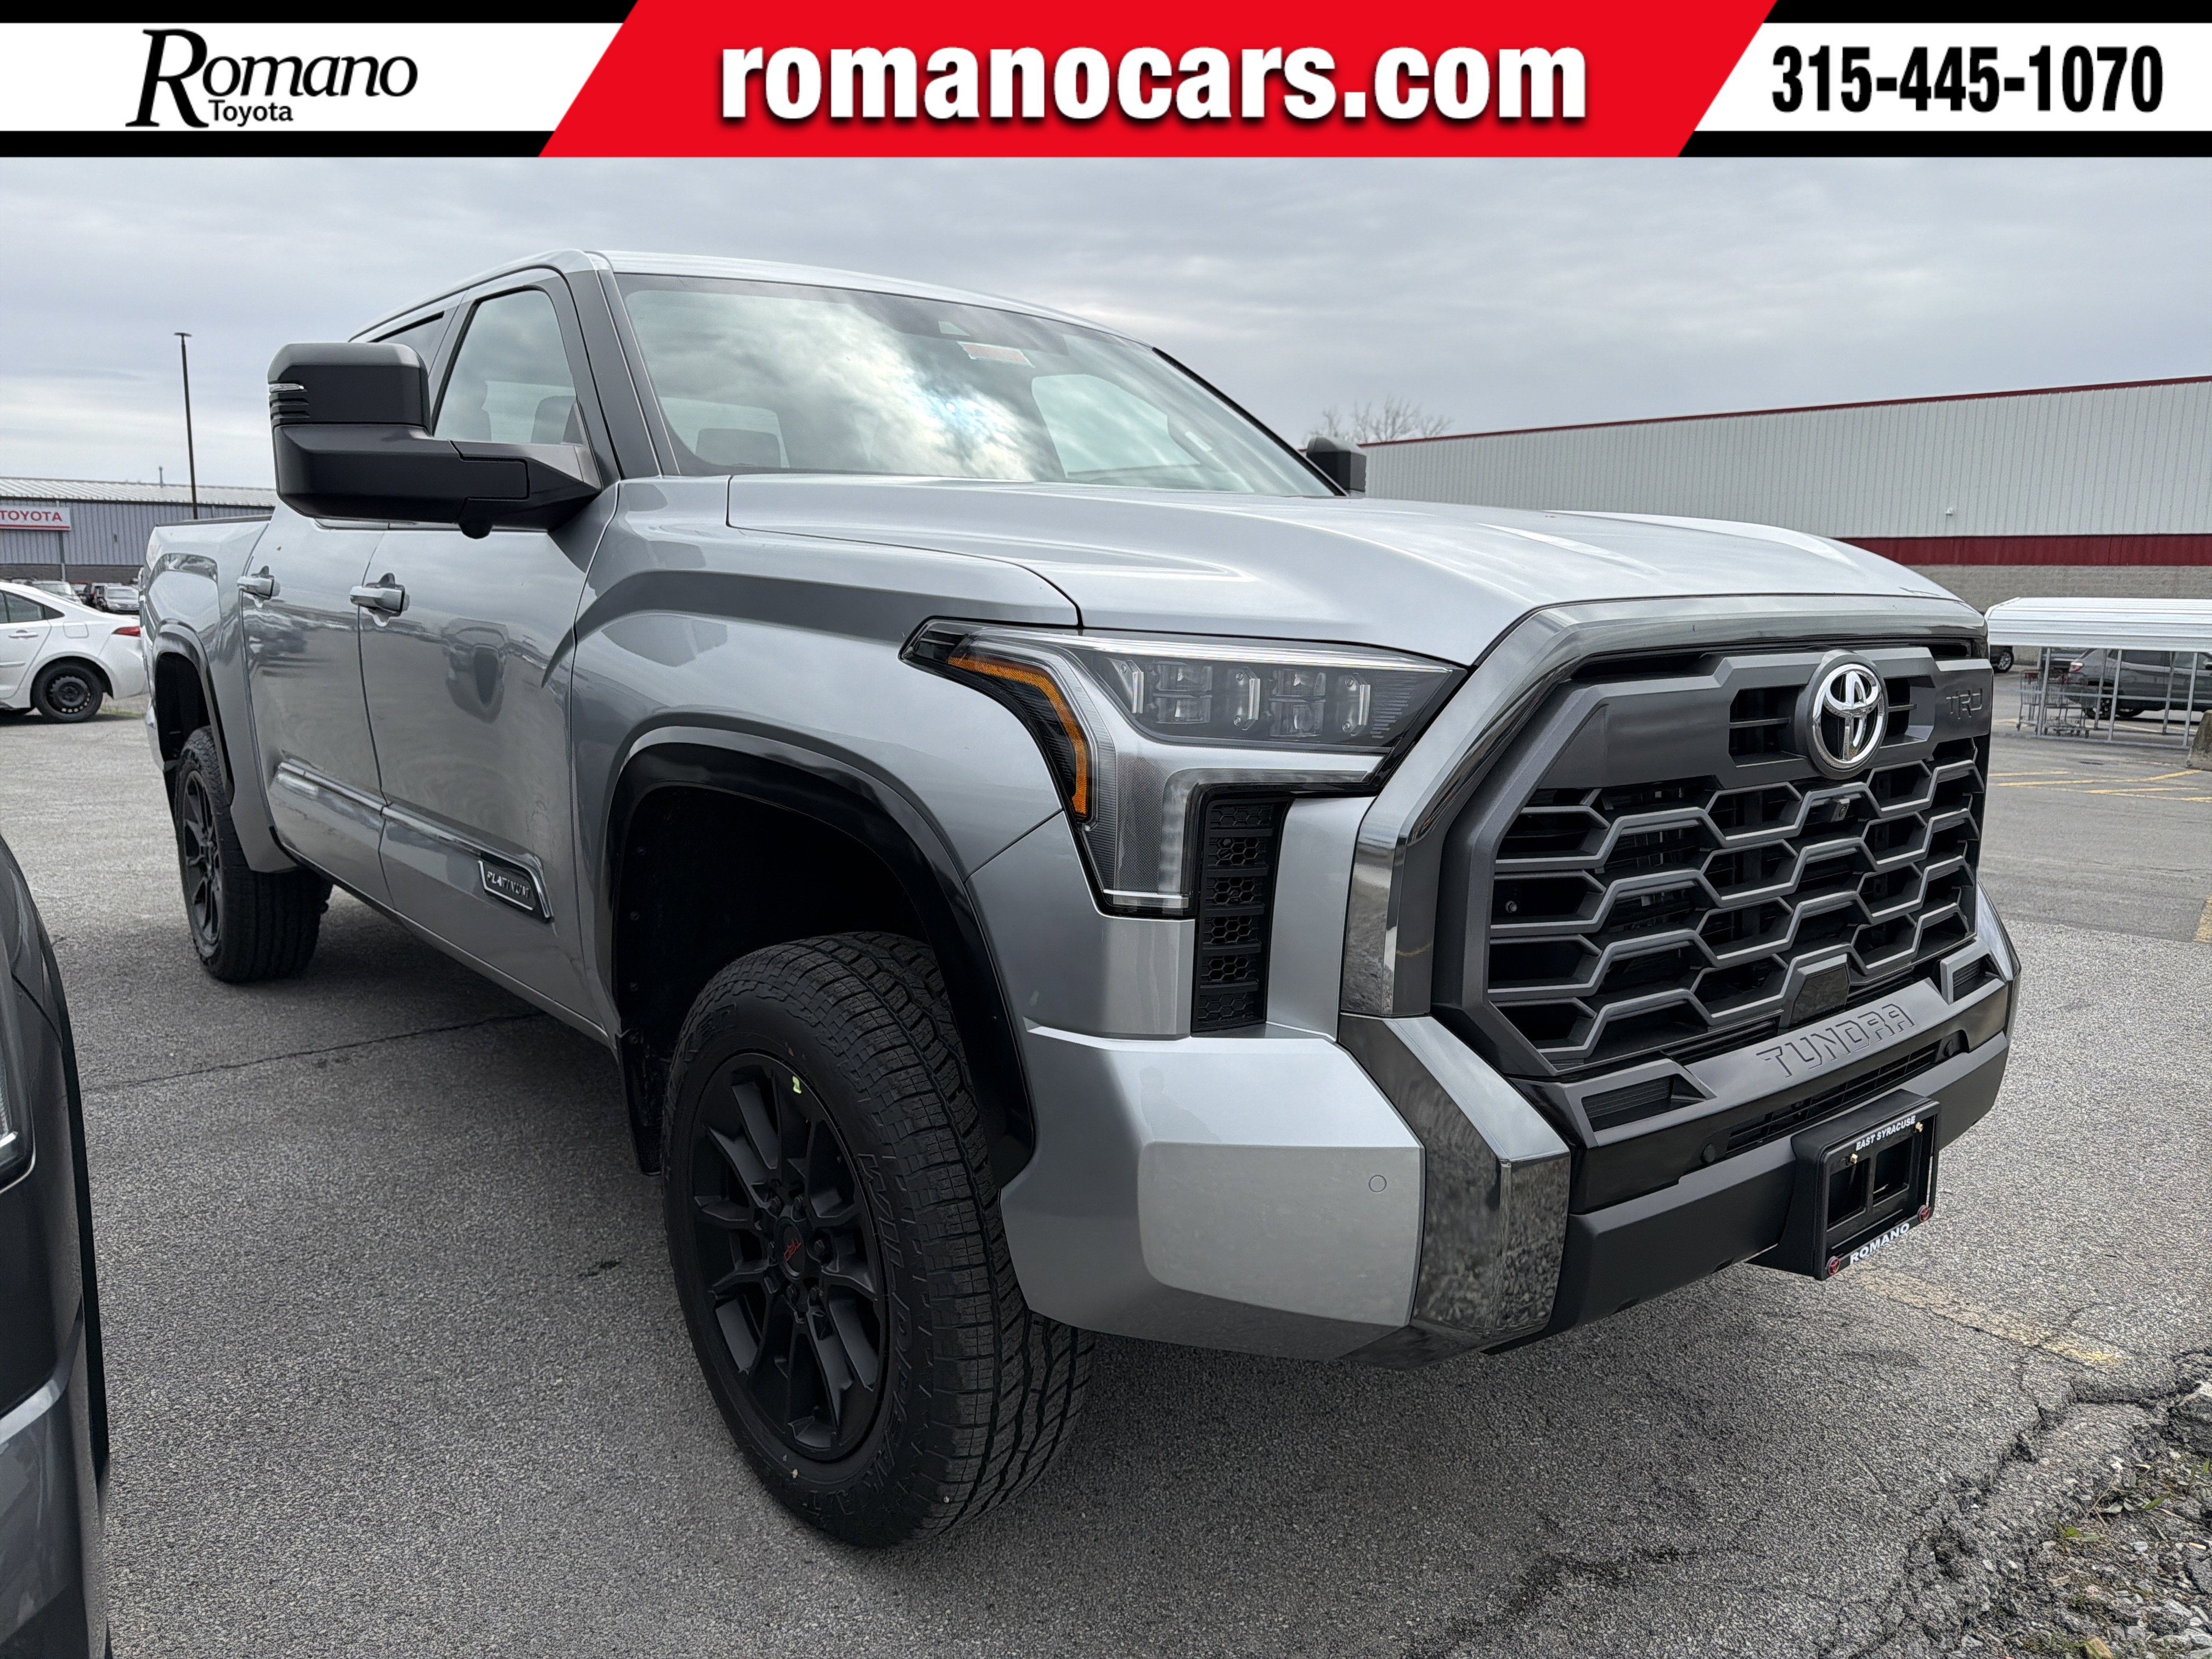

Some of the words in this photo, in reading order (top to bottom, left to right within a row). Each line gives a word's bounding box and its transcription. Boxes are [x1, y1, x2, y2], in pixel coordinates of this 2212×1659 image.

[0, 510, 63, 522] TOYOTA
[1945, 687, 1983, 720] TRD
[487, 871, 530, 898] PLATINUM
[1756, 1003, 1915, 1079] TUNDRA
[1855, 1133, 1876, 1152] EAST
[1876, 1115, 1916, 1141] SYRACUSE
[1849, 1222, 1910, 1265] ROMANO
